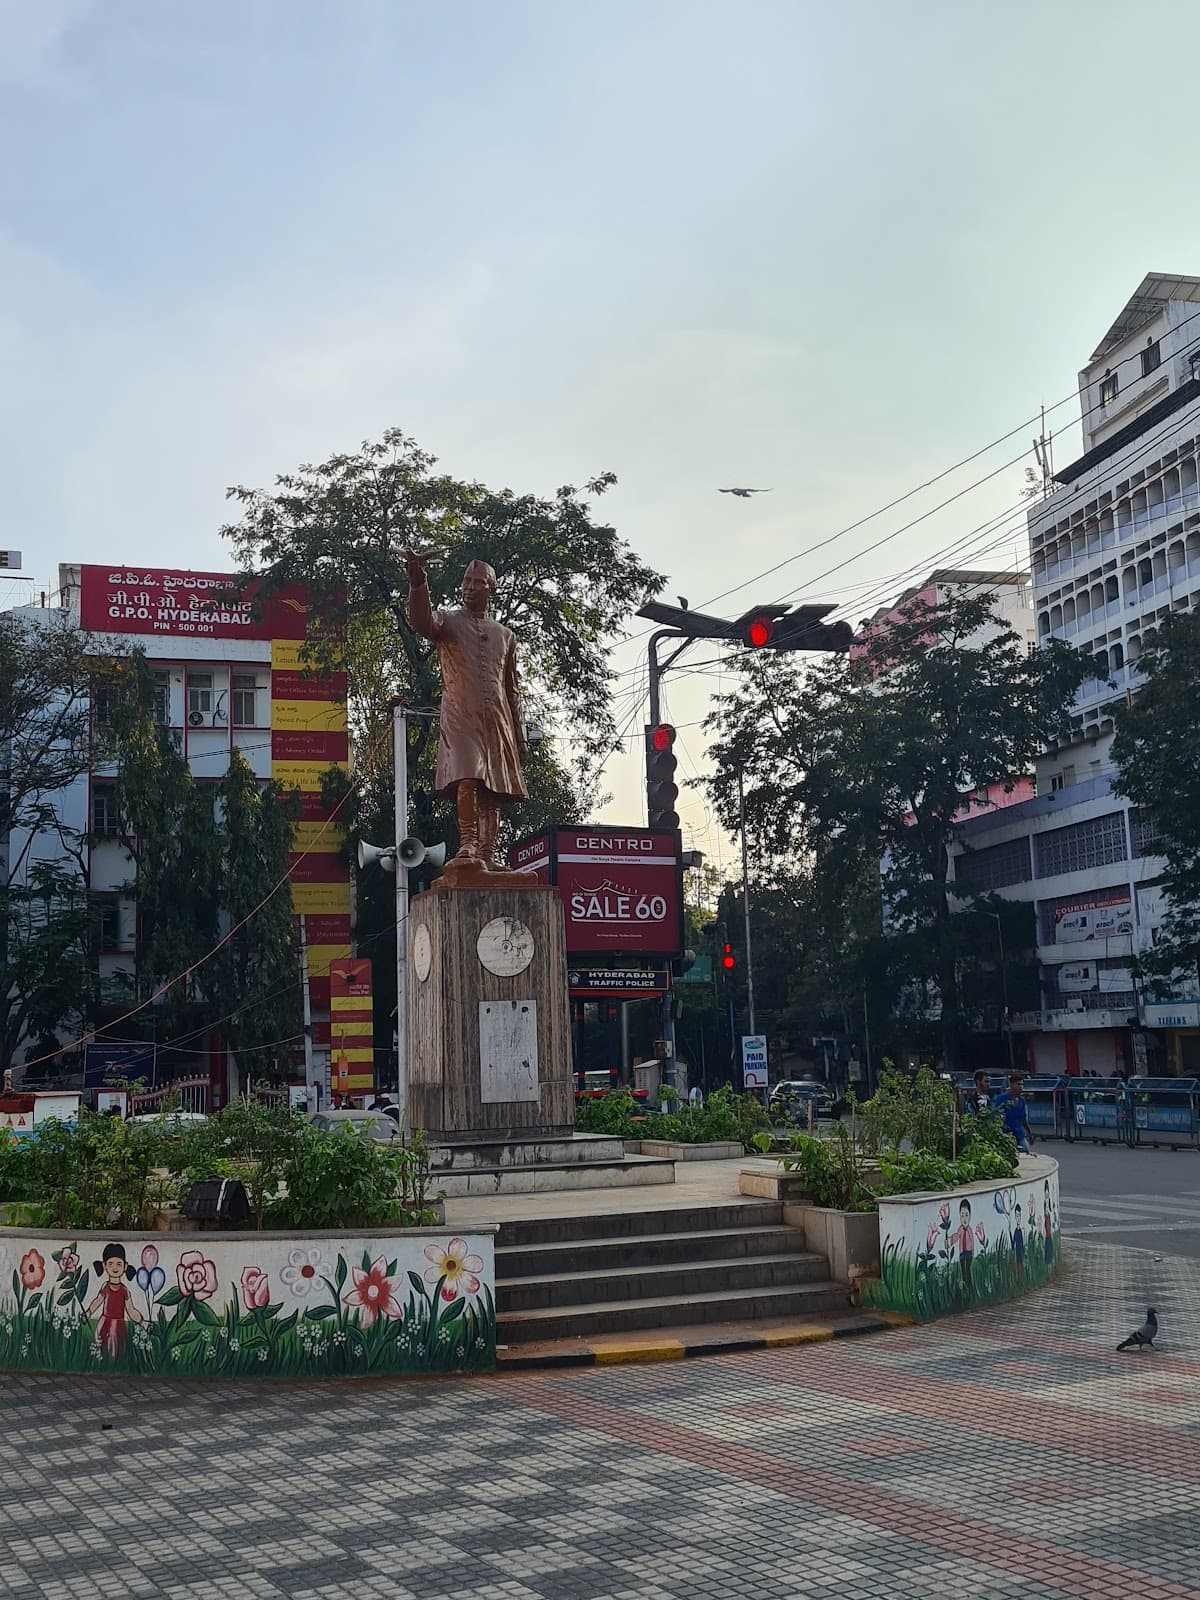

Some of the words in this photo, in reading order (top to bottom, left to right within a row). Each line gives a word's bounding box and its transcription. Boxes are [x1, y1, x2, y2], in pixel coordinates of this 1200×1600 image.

[107, 591, 181, 608] जी.पी.ओ.
[109, 607, 152, 619] G.P.O.
[158, 608, 251, 624] HYDERABAD
[154, 622, 170, 630] PIN
[576, 837, 653, 851] CENTRO
[518, 841, 544, 862] CENTRO
[571, 896, 630, 918] SALE
[635, 896, 667, 919] 60
[1056, 902, 1096, 915] COURIER
[588, 971, 655, 979] HYDERABAD
[746, 1053, 764, 1061] PAID
[744, 1062, 767, 1070] PARKING
